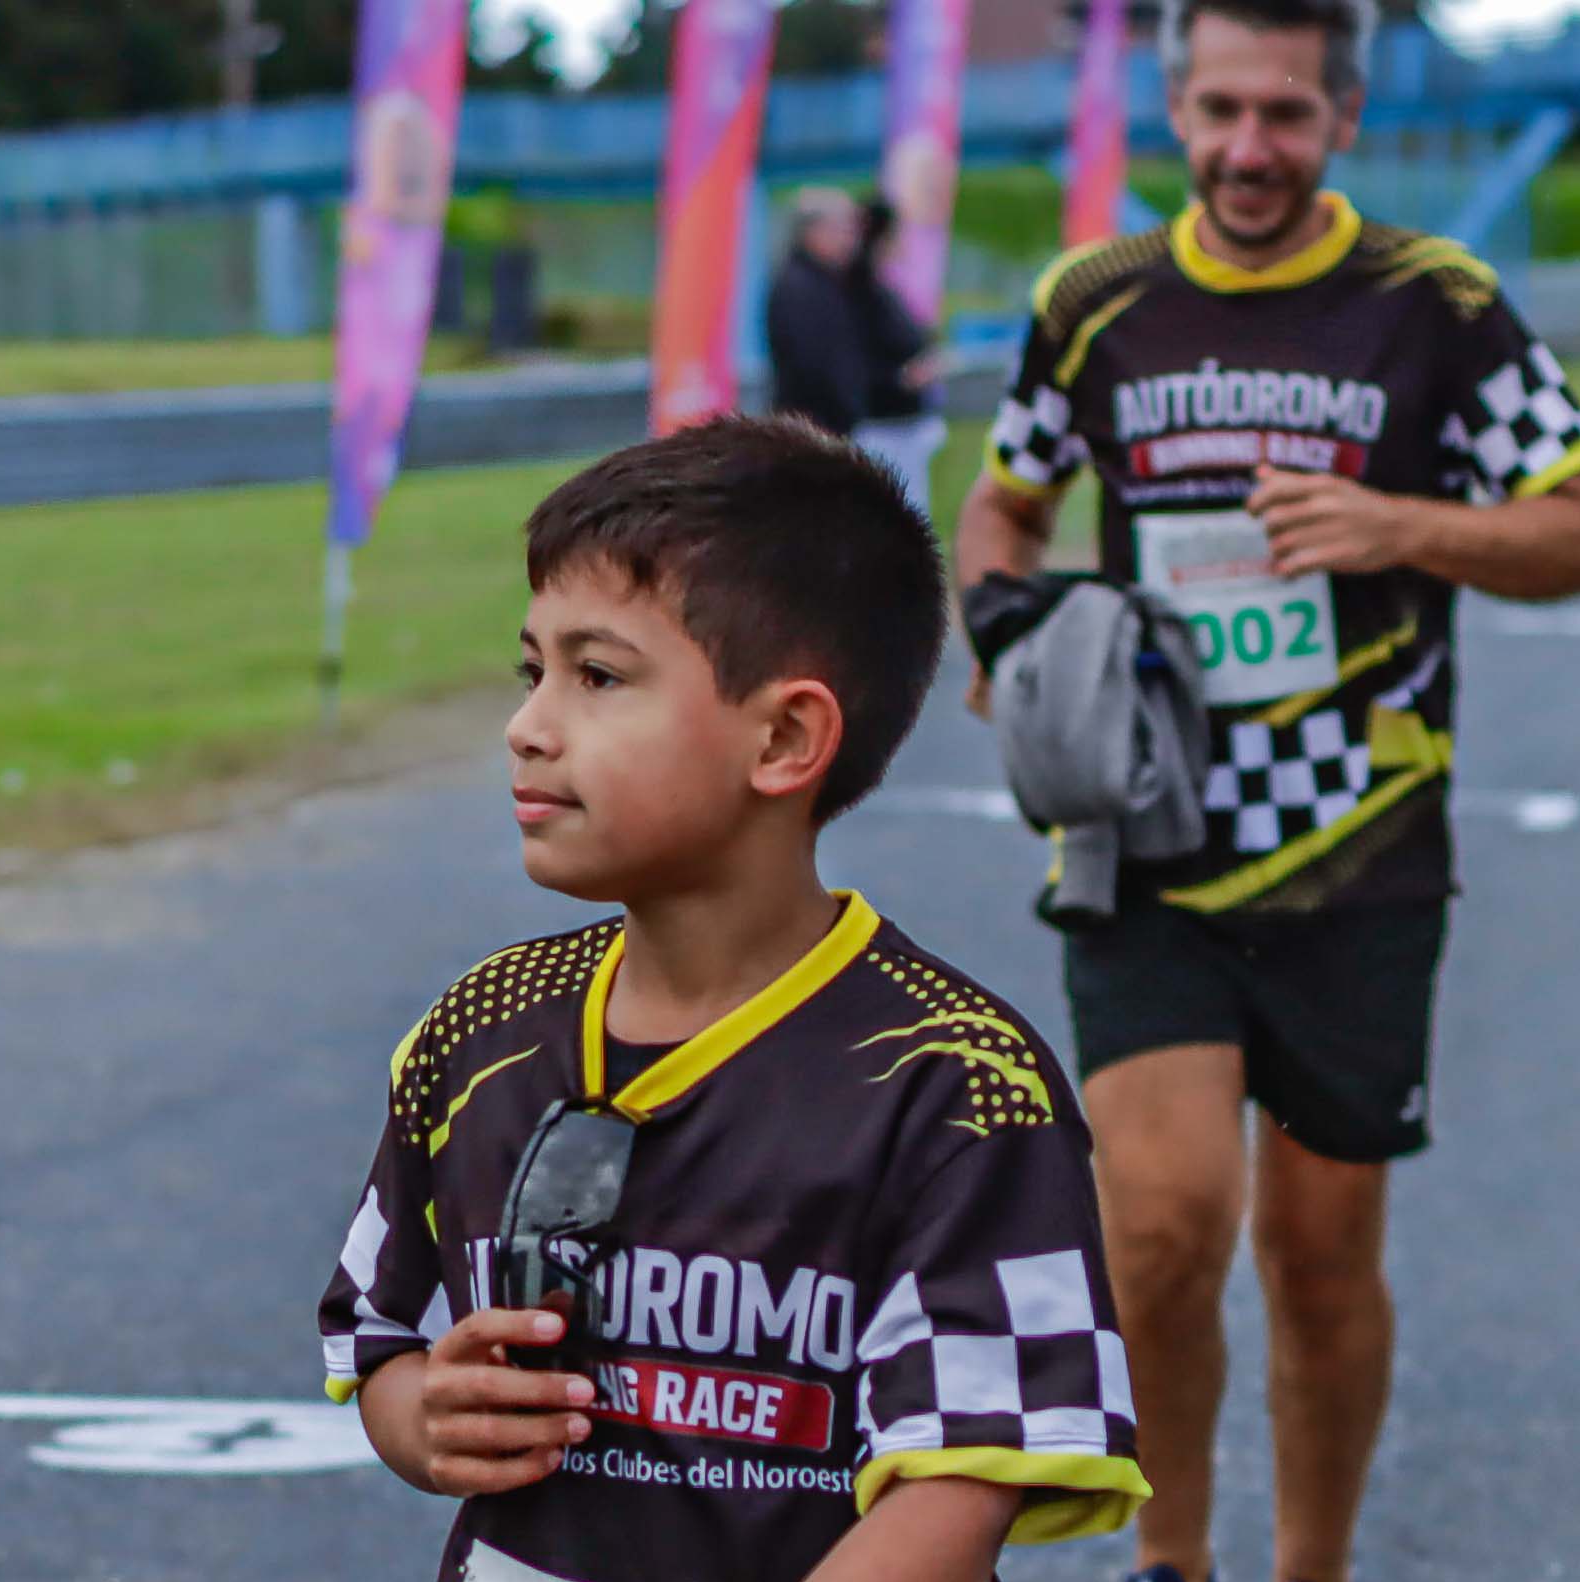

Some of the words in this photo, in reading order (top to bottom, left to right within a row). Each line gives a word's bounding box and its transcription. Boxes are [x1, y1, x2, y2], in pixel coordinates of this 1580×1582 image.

[1114, 357, 1388, 442] AUTÓDROMO
[654, 1369, 784, 1440] RACE
[602, 1449, 682, 1483] Clubes
[687, 1457, 733, 1489] del
